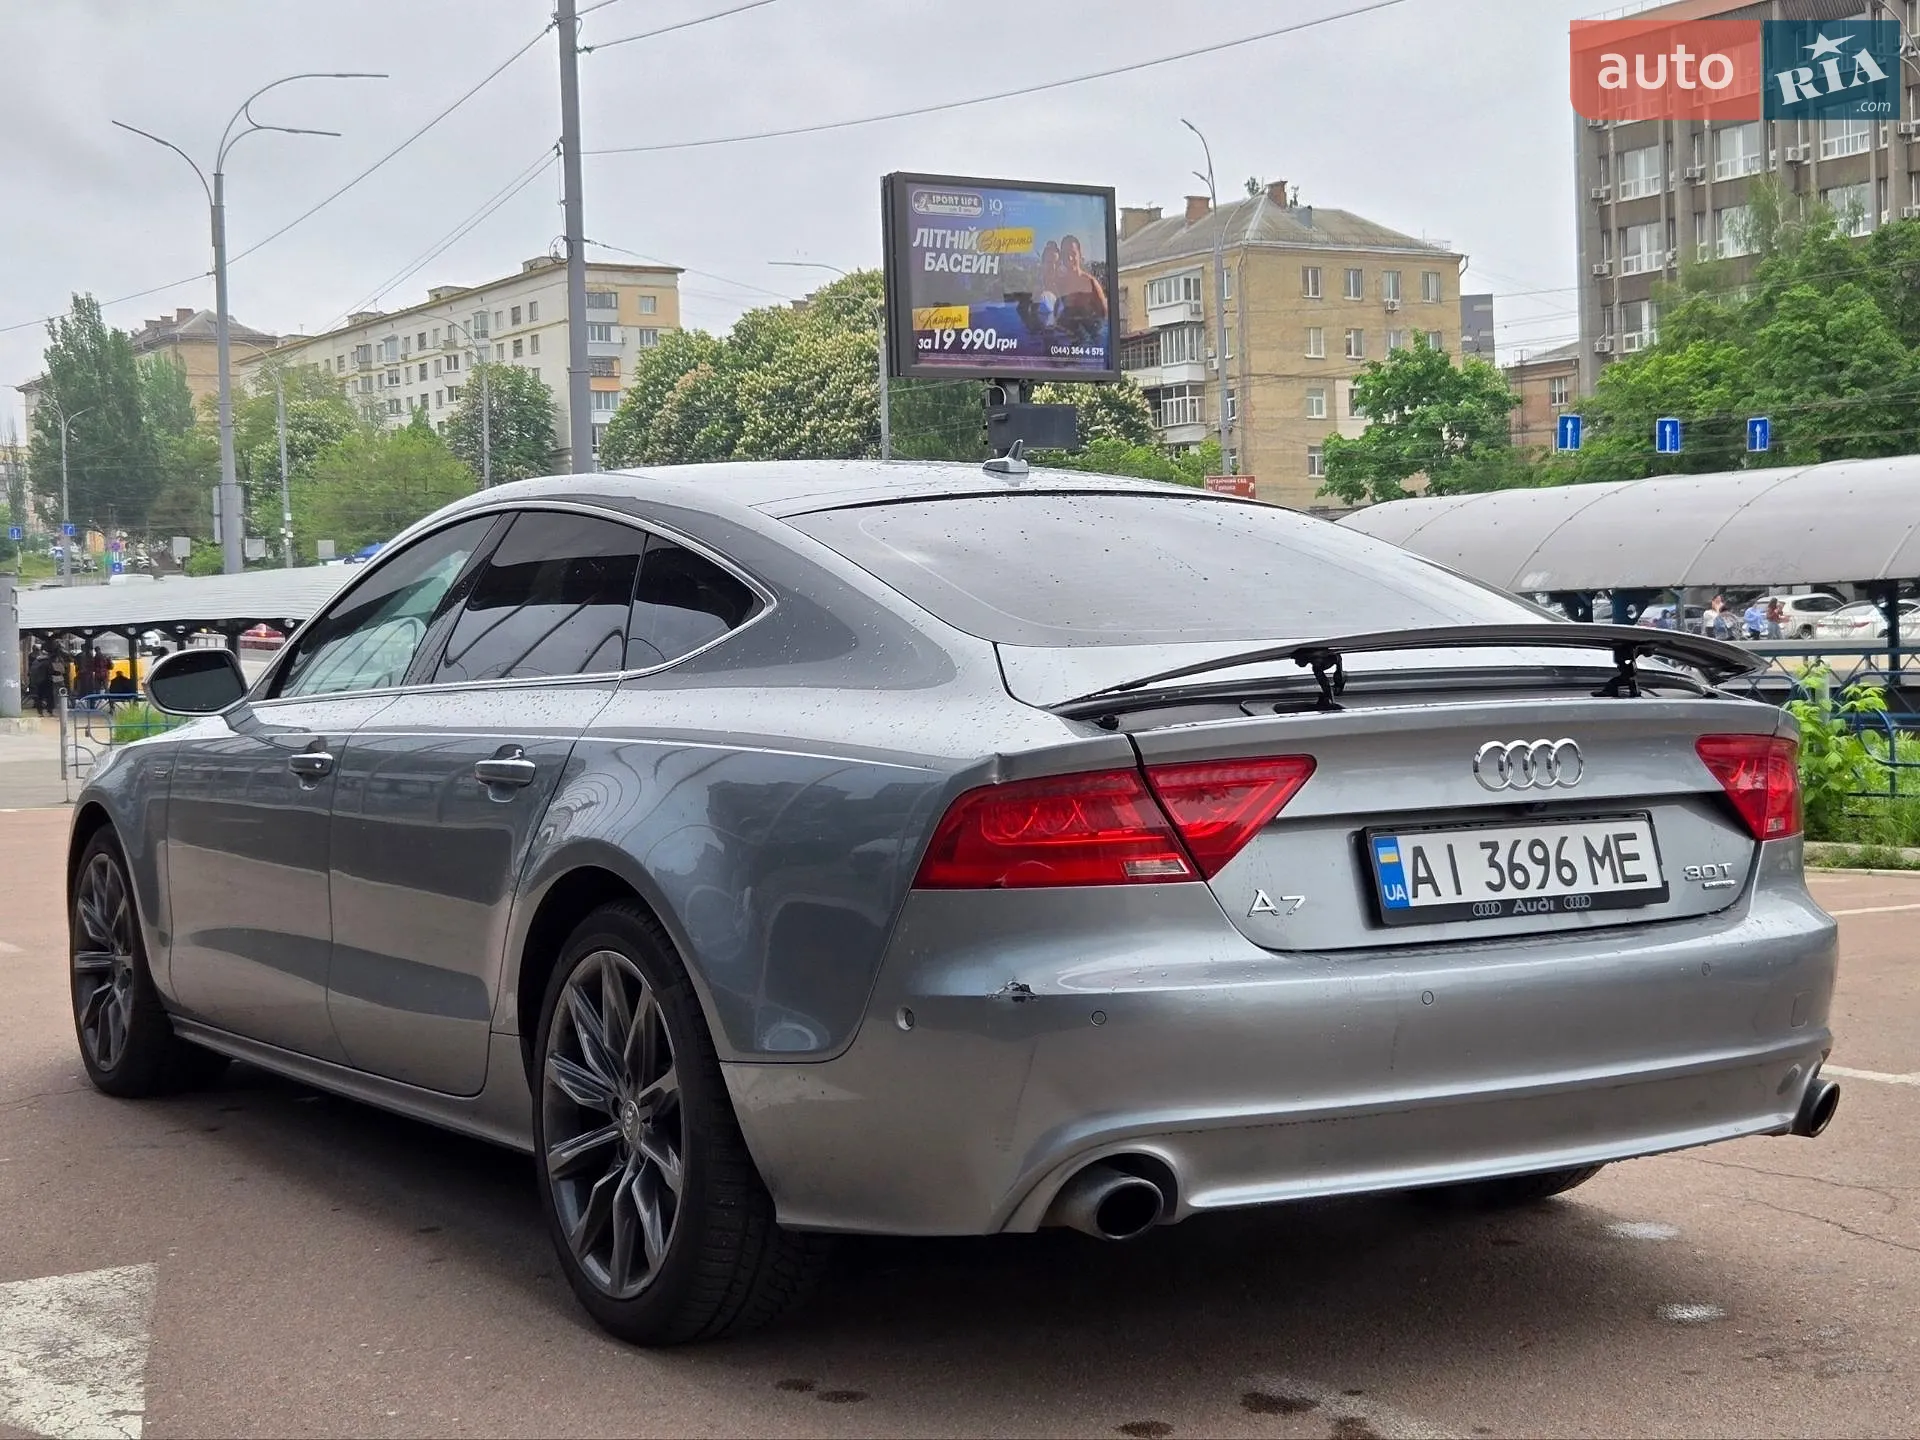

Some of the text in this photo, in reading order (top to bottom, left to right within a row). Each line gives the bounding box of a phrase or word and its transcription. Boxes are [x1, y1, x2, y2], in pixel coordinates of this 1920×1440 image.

[932, 194, 959, 206] SPORT
[912, 226, 979, 250] ЛІТНІЙ
[924, 250, 1000, 275] БАСЕЙН
[918, 329, 1018, 351] за 19 990 грн
[1411, 832, 1648, 899] AI 3696 ME
[1246, 888, 1306, 918] A7
[1383, 884, 1407, 901] UA
[1512, 899, 1555, 914] Audi
